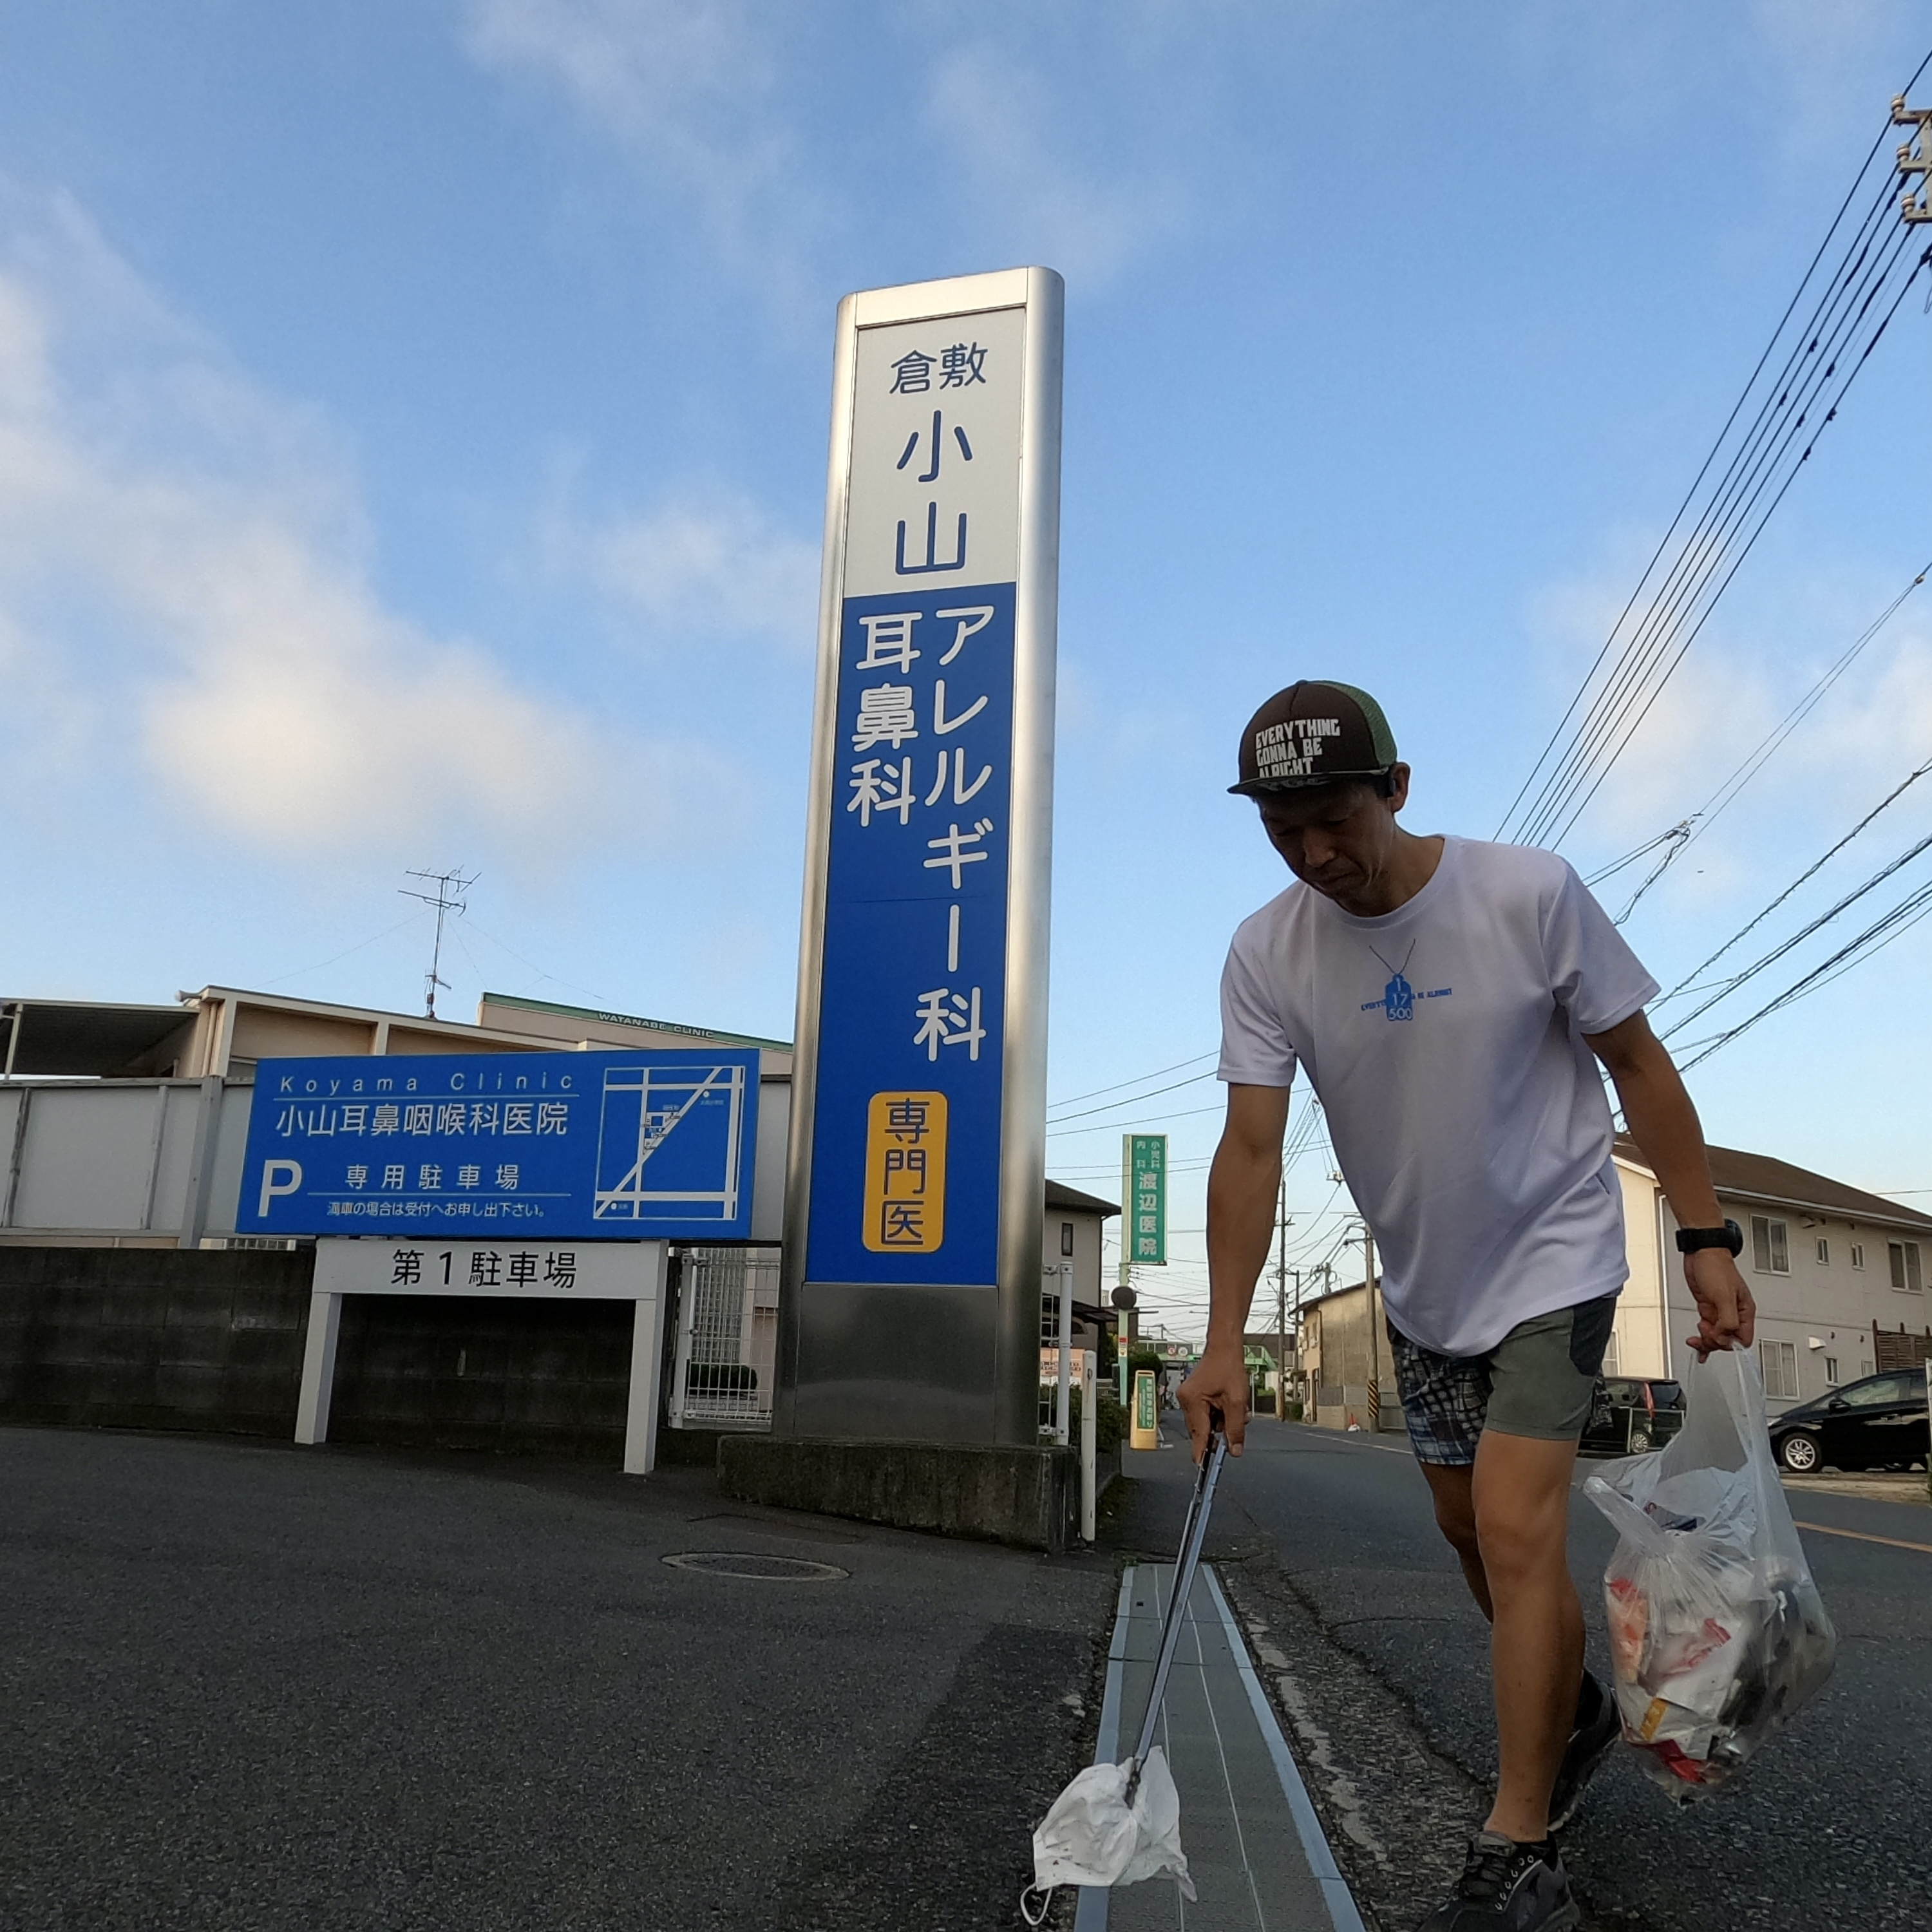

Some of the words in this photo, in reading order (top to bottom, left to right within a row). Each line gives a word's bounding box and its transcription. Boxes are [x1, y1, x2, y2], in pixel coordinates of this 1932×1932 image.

[889, 342, 988, 394] 倉敷
[895, 410, 973, 574] 小山
[847, 612, 923, 827] 耳鼻科
[1256, 719, 1341, 749] EVERYTHING
[1256, 741, 1298, 767] GONNA
[1302, 737, 1323, 757] BE
[914, 605, 994, 1062] アレルギー科
[1388, 1007, 1412, 1019] 500
[1392, 994, 1408, 1005] 17
[598, 1012, 667, 1030] WATANABE
[673, 1025, 714, 1038] CLINIC
[281, 1075, 417, 1096] Koyama
[451, 1072, 572, 1090] Clinic
[276, 1102, 568, 1137] 小山耳鼻咽喉科医院
[345, 1164, 520, 1190] 専用駐車場
[882, 1098, 930, 1245] 専門医
[258, 1159, 302, 1217] P
